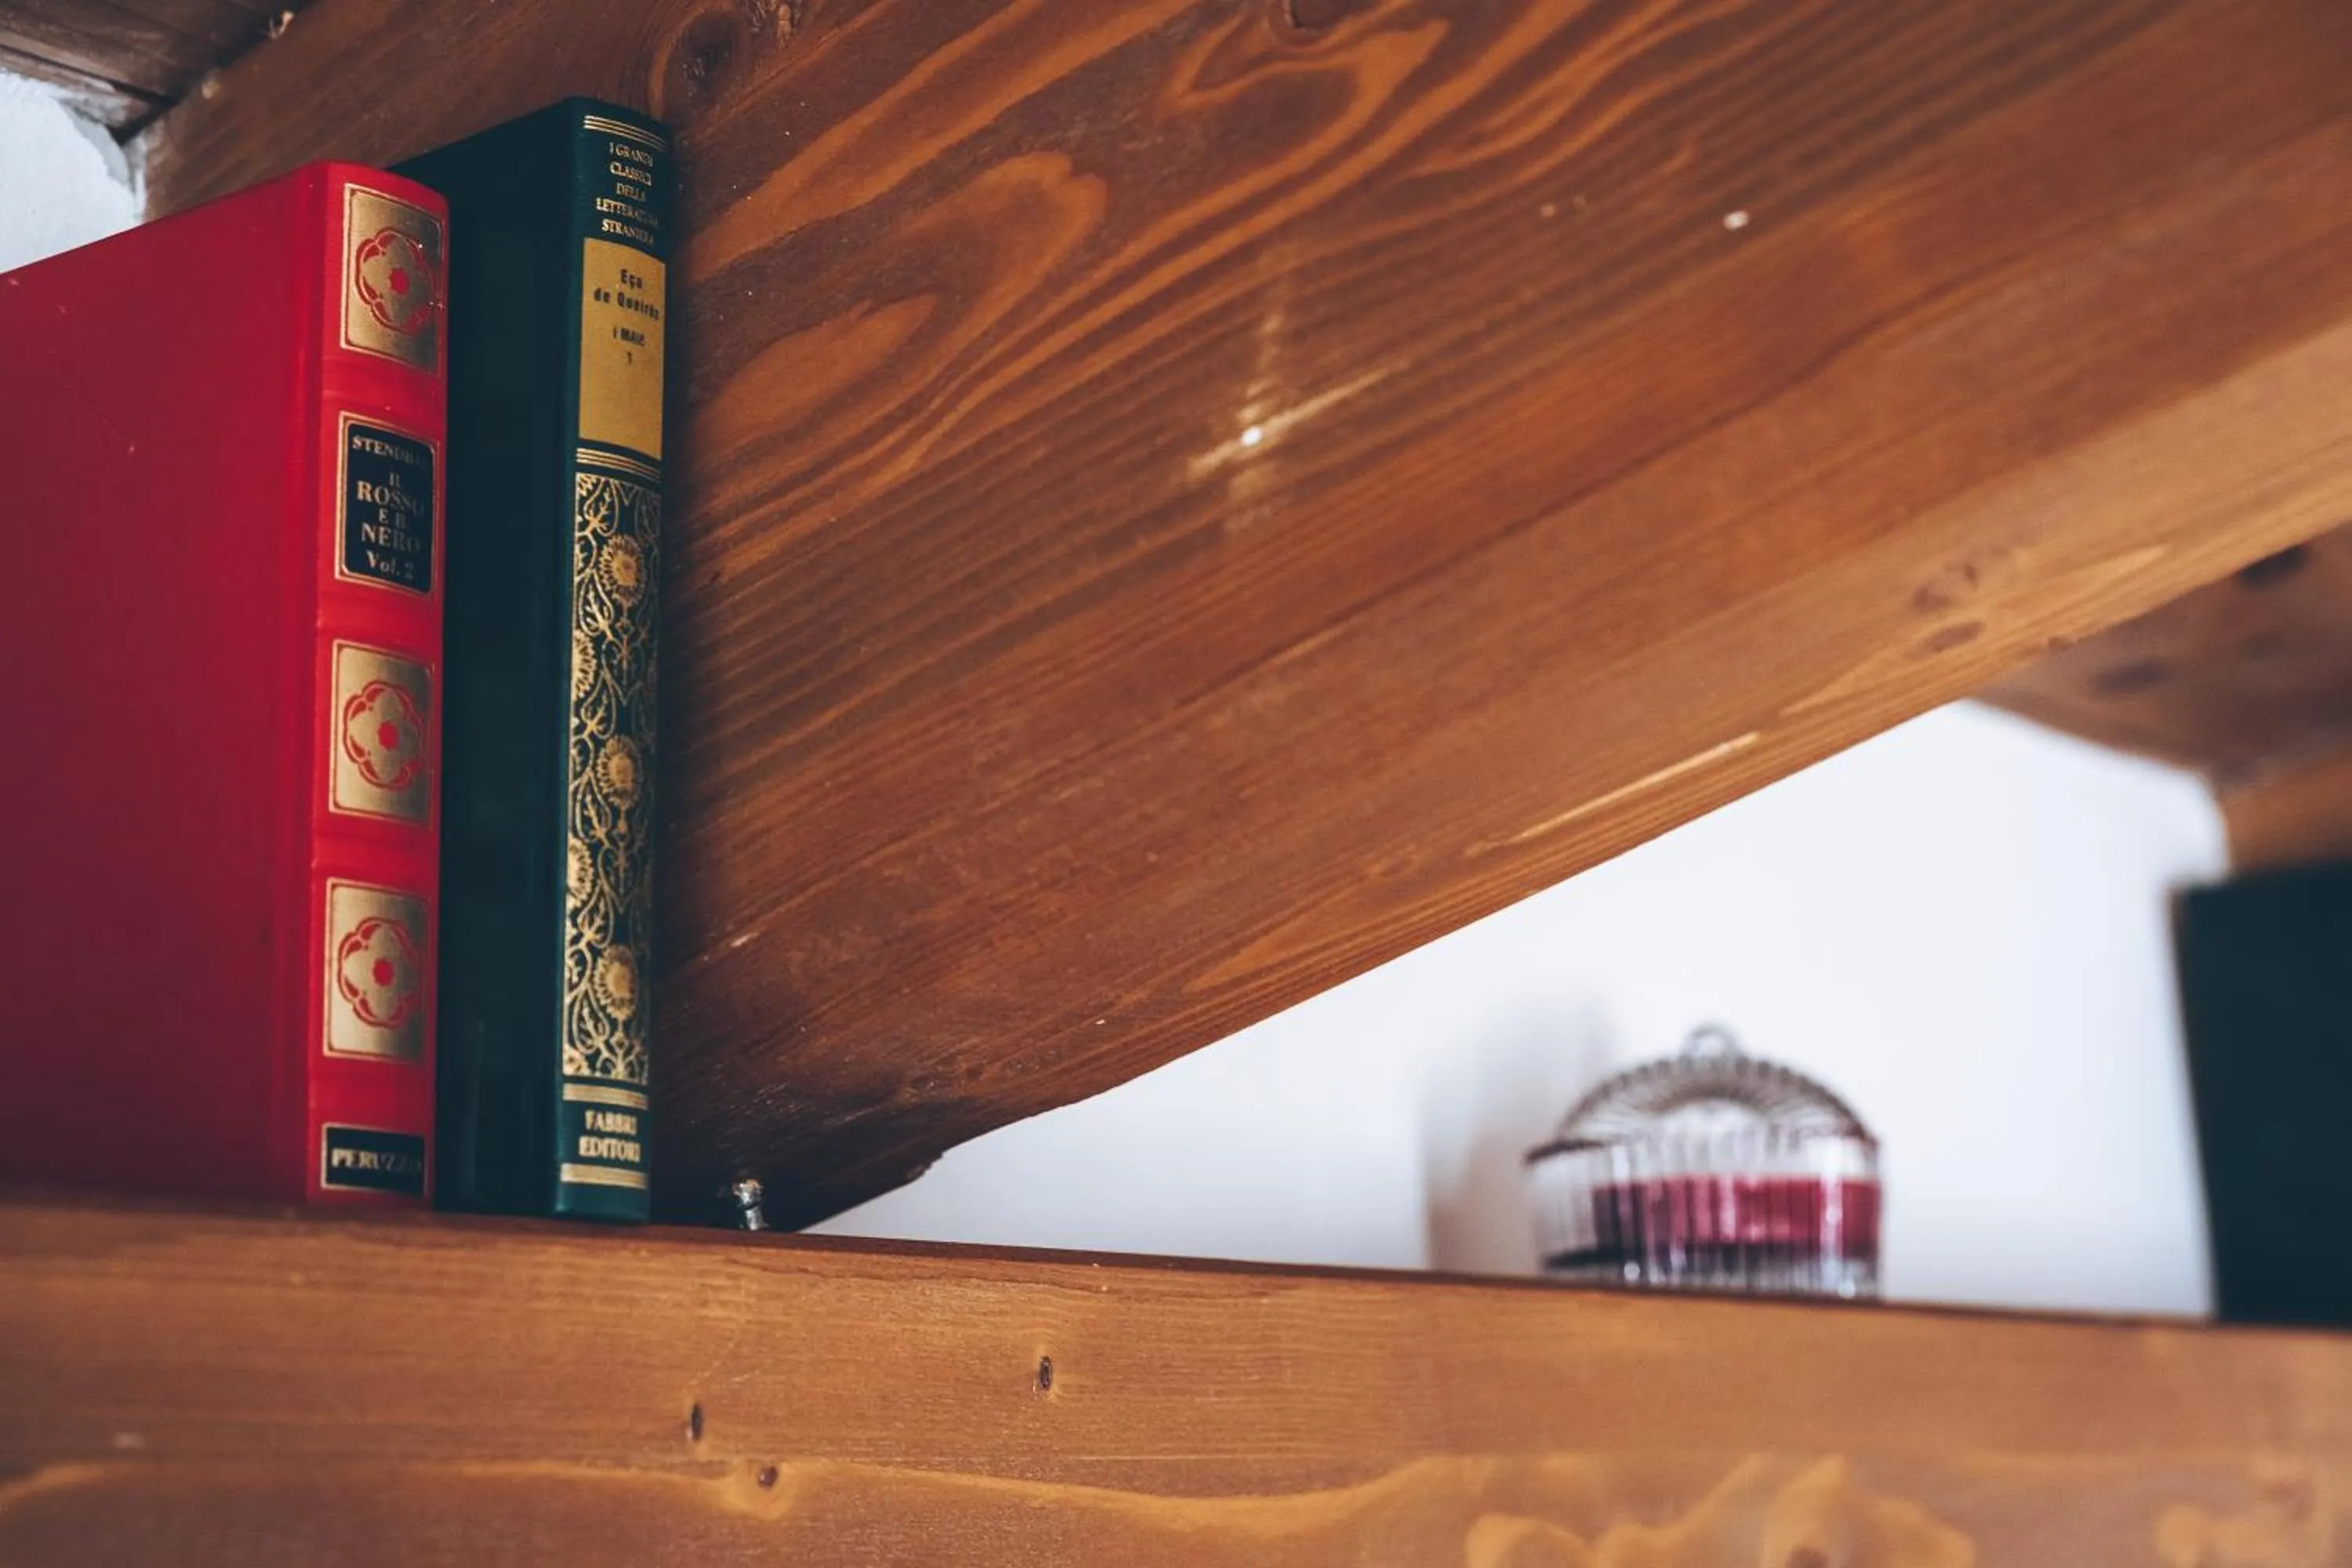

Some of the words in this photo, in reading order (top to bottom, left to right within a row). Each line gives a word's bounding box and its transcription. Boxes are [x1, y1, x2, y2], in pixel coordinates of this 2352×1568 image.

[594, 288, 611, 303] de
[352, 434, 428, 466] STENDH
[378, 507, 390, 524] E
[361, 521, 420, 554] NERO
[366, 550, 401, 576] Vol.
[585, 1109, 638, 1135] FABBRI
[578, 1134, 642, 1163] EDITORI
